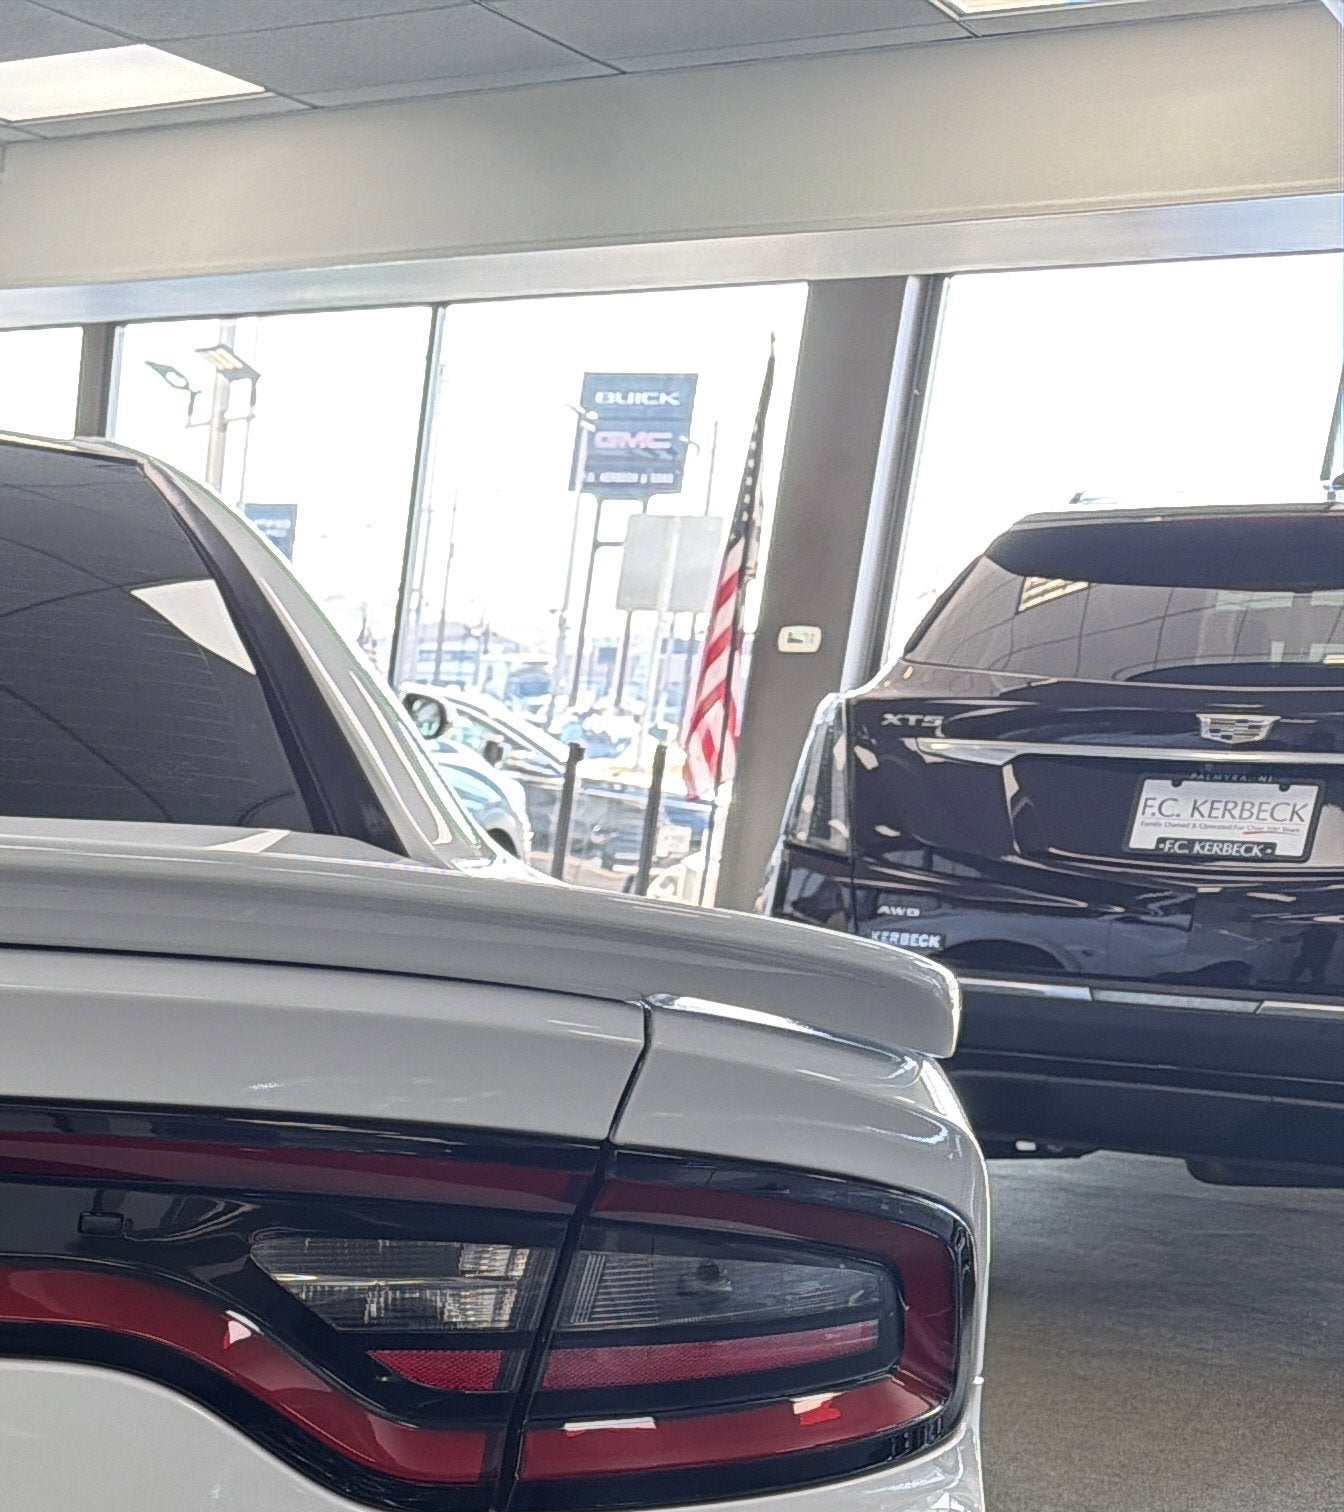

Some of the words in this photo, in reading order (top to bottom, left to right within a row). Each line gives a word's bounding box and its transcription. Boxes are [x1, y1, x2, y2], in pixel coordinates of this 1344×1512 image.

[595, 391, 680, 406] BUICK
[594, 431, 673, 449] GMC
[1141, 797, 1181, 818] F.C.
[1190, 798, 1308, 823] KERBECK
[1193, 841, 1265, 857] KERBECK
[877, 904, 920, 918] AWD
[871, 930, 942, 949] KERBECK
